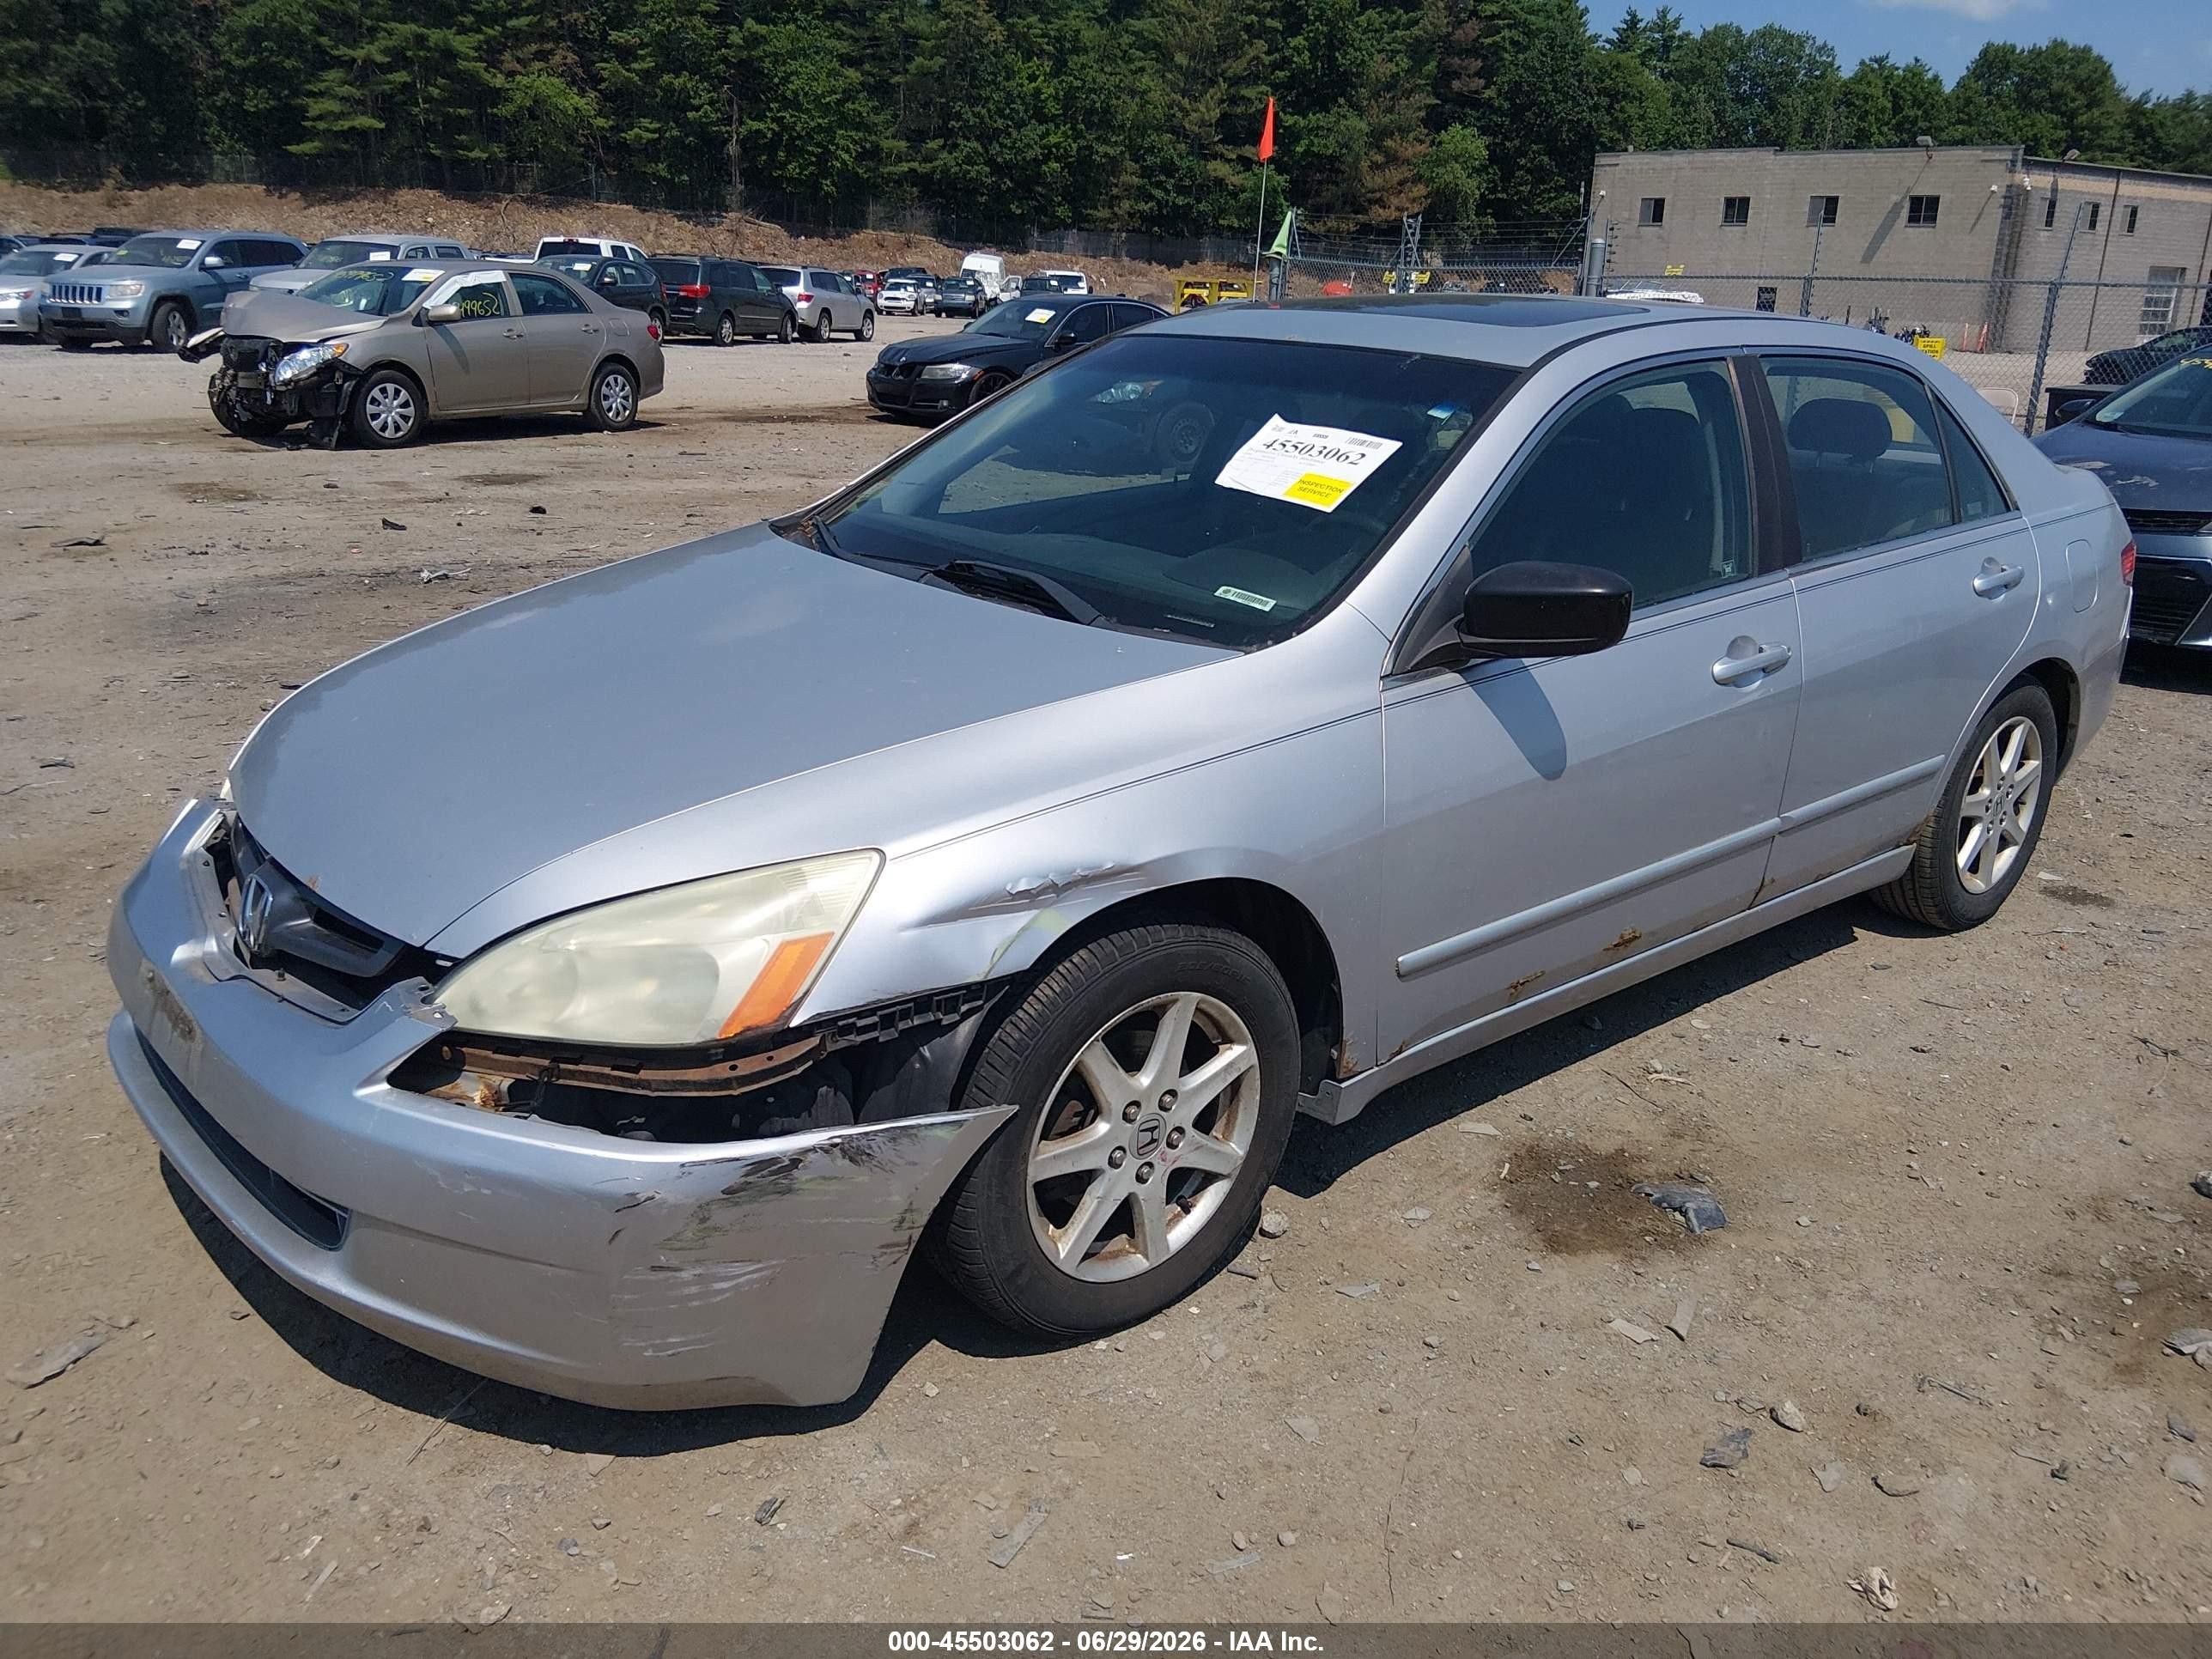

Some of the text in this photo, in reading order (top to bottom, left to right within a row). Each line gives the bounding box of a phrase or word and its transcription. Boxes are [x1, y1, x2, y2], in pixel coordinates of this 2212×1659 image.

[1262, 438, 1366, 465] 45503062
[1297, 486, 1332, 498] SERVICE
[1298, 479, 1345, 494] INSPECTION
